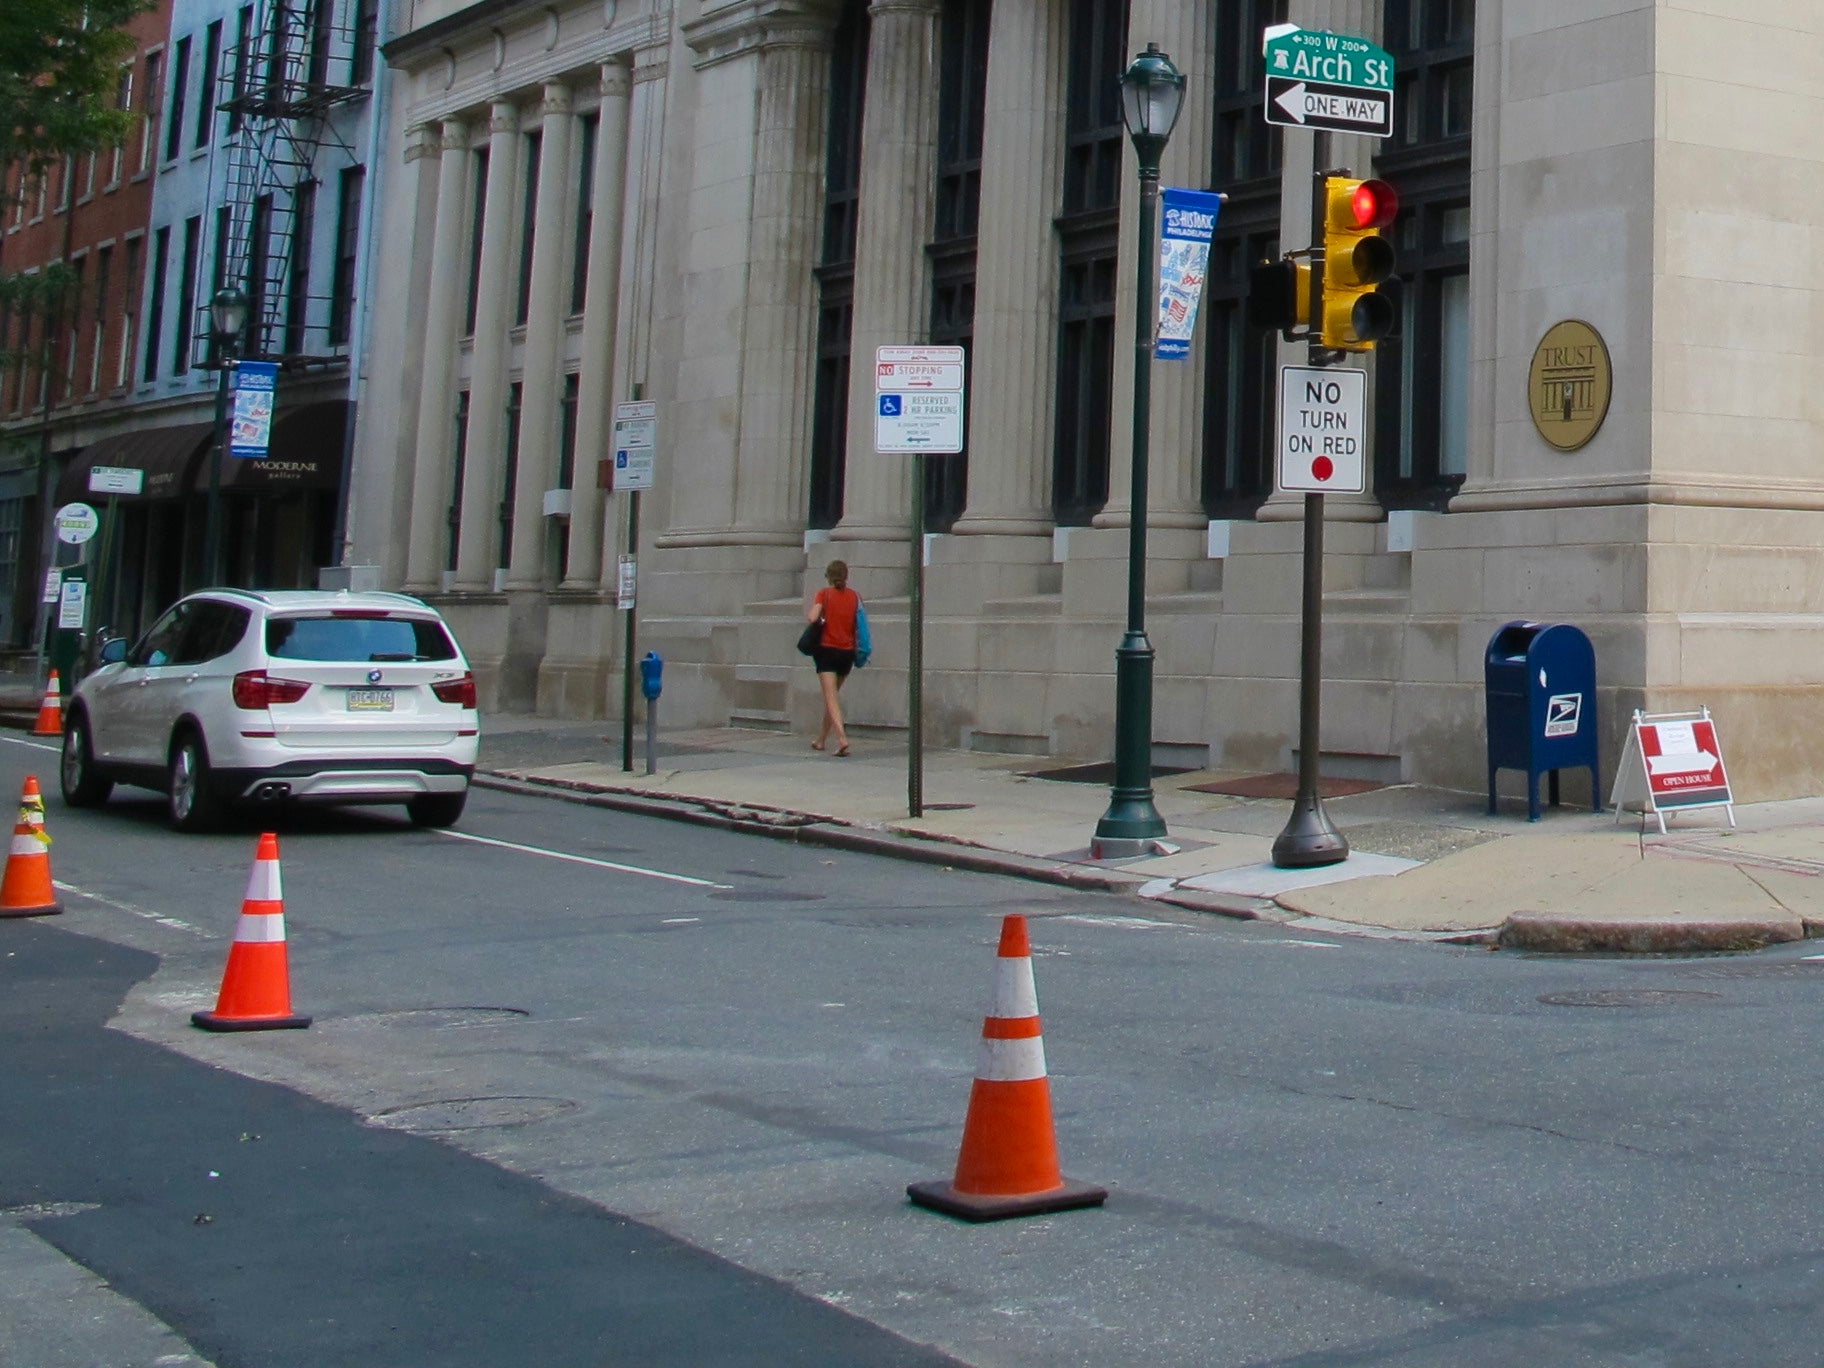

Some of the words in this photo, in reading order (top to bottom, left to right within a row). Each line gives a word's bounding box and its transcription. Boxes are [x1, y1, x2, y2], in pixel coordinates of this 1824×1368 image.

[1303, 36, 1321, 47] 300
[1325, 36, 1339, 51] W
[1341, 40, 1360, 52] 200
[1293, 49, 1352, 82] Arch
[1364, 58, 1389, 87] St
[1304, 95, 1340, 116] ONE
[1346, 99, 1379, 120] WAY
[1541, 345, 1597, 367] TRUST
[879, 366, 893, 375] NO
[899, 366, 943, 375] STOPPING
[912, 396, 950, 405] RESERVED
[1305, 381, 1341, 405] NO
[925, 405, 958, 415] PARKING
[1300, 410, 1347, 430] TURN
[1288, 434, 1313, 453] ON
[1323, 436, 1357, 455] RED
[253, 460, 318, 472] MODERNE
[1662, 776, 1685, 786] OPEN
[1685, 773, 1712, 785] HOUSE
